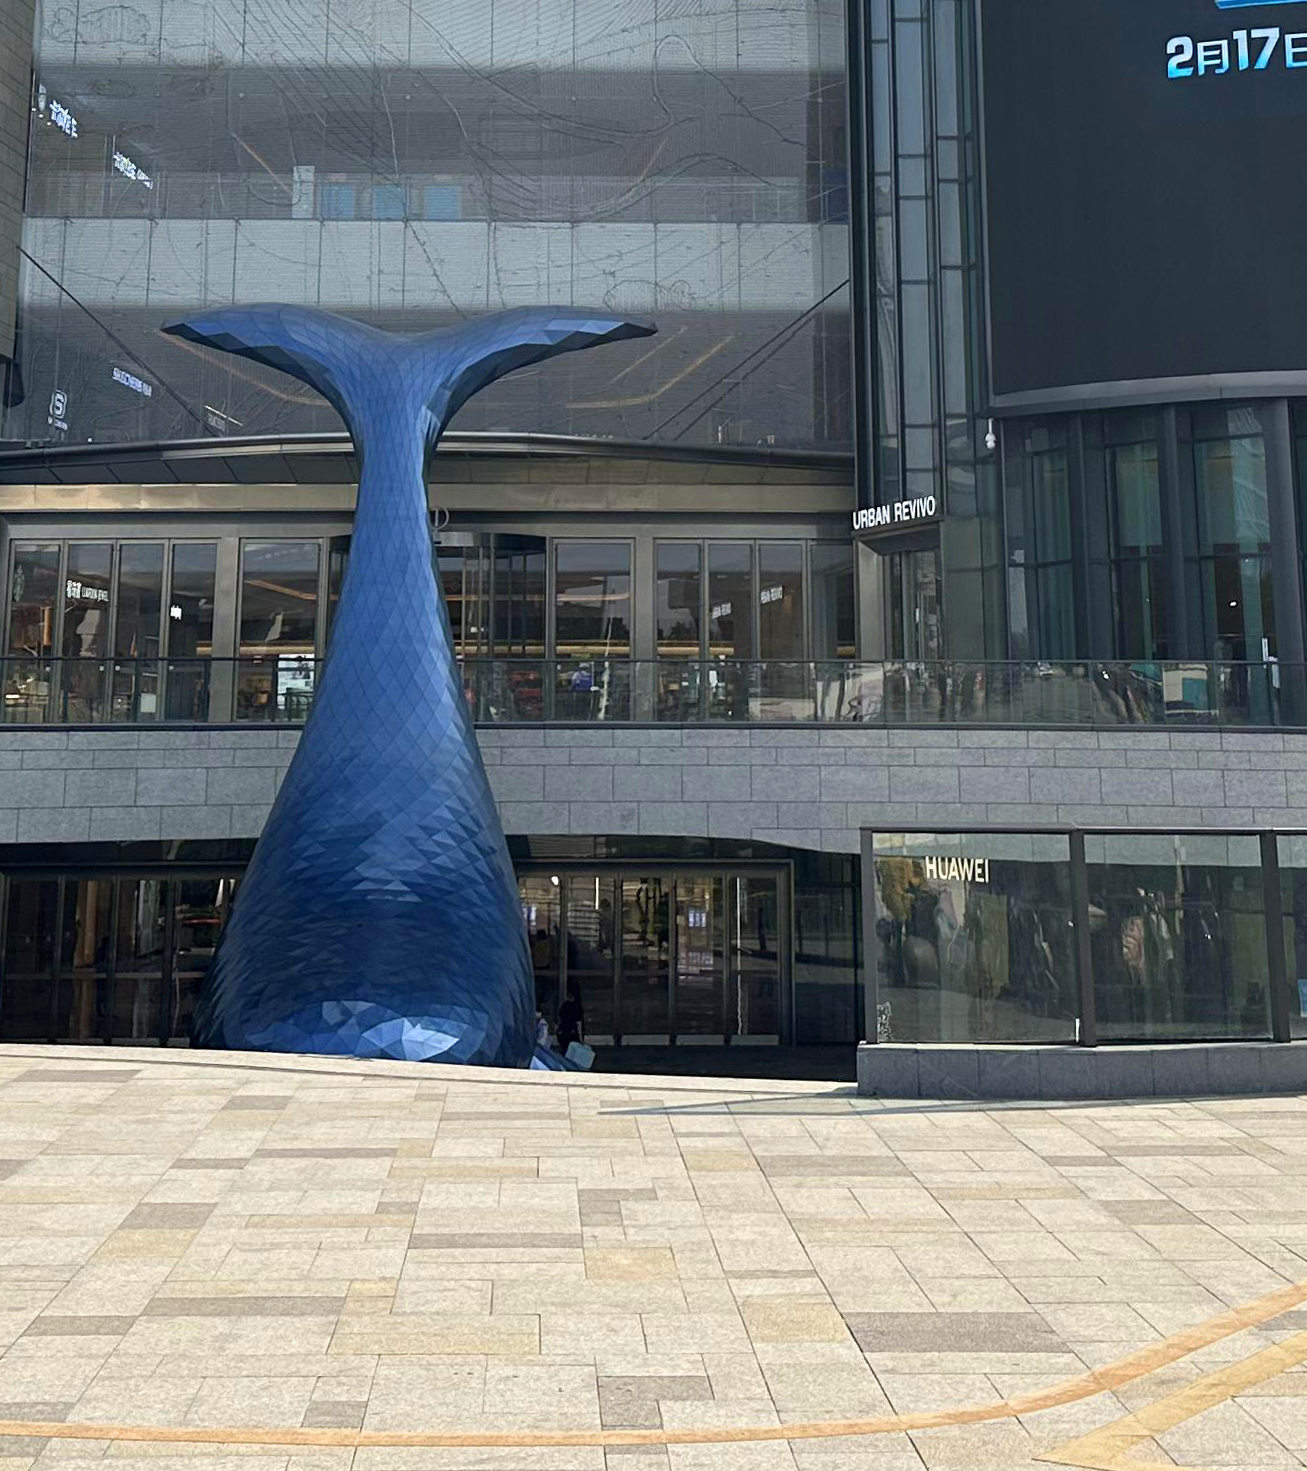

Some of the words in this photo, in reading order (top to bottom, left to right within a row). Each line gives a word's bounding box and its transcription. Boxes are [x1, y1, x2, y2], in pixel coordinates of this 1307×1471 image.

[852, 505, 890, 530] URBAN
[894, 496, 936, 522] REVIVO
[925, 855, 989, 883] HUAWEI
